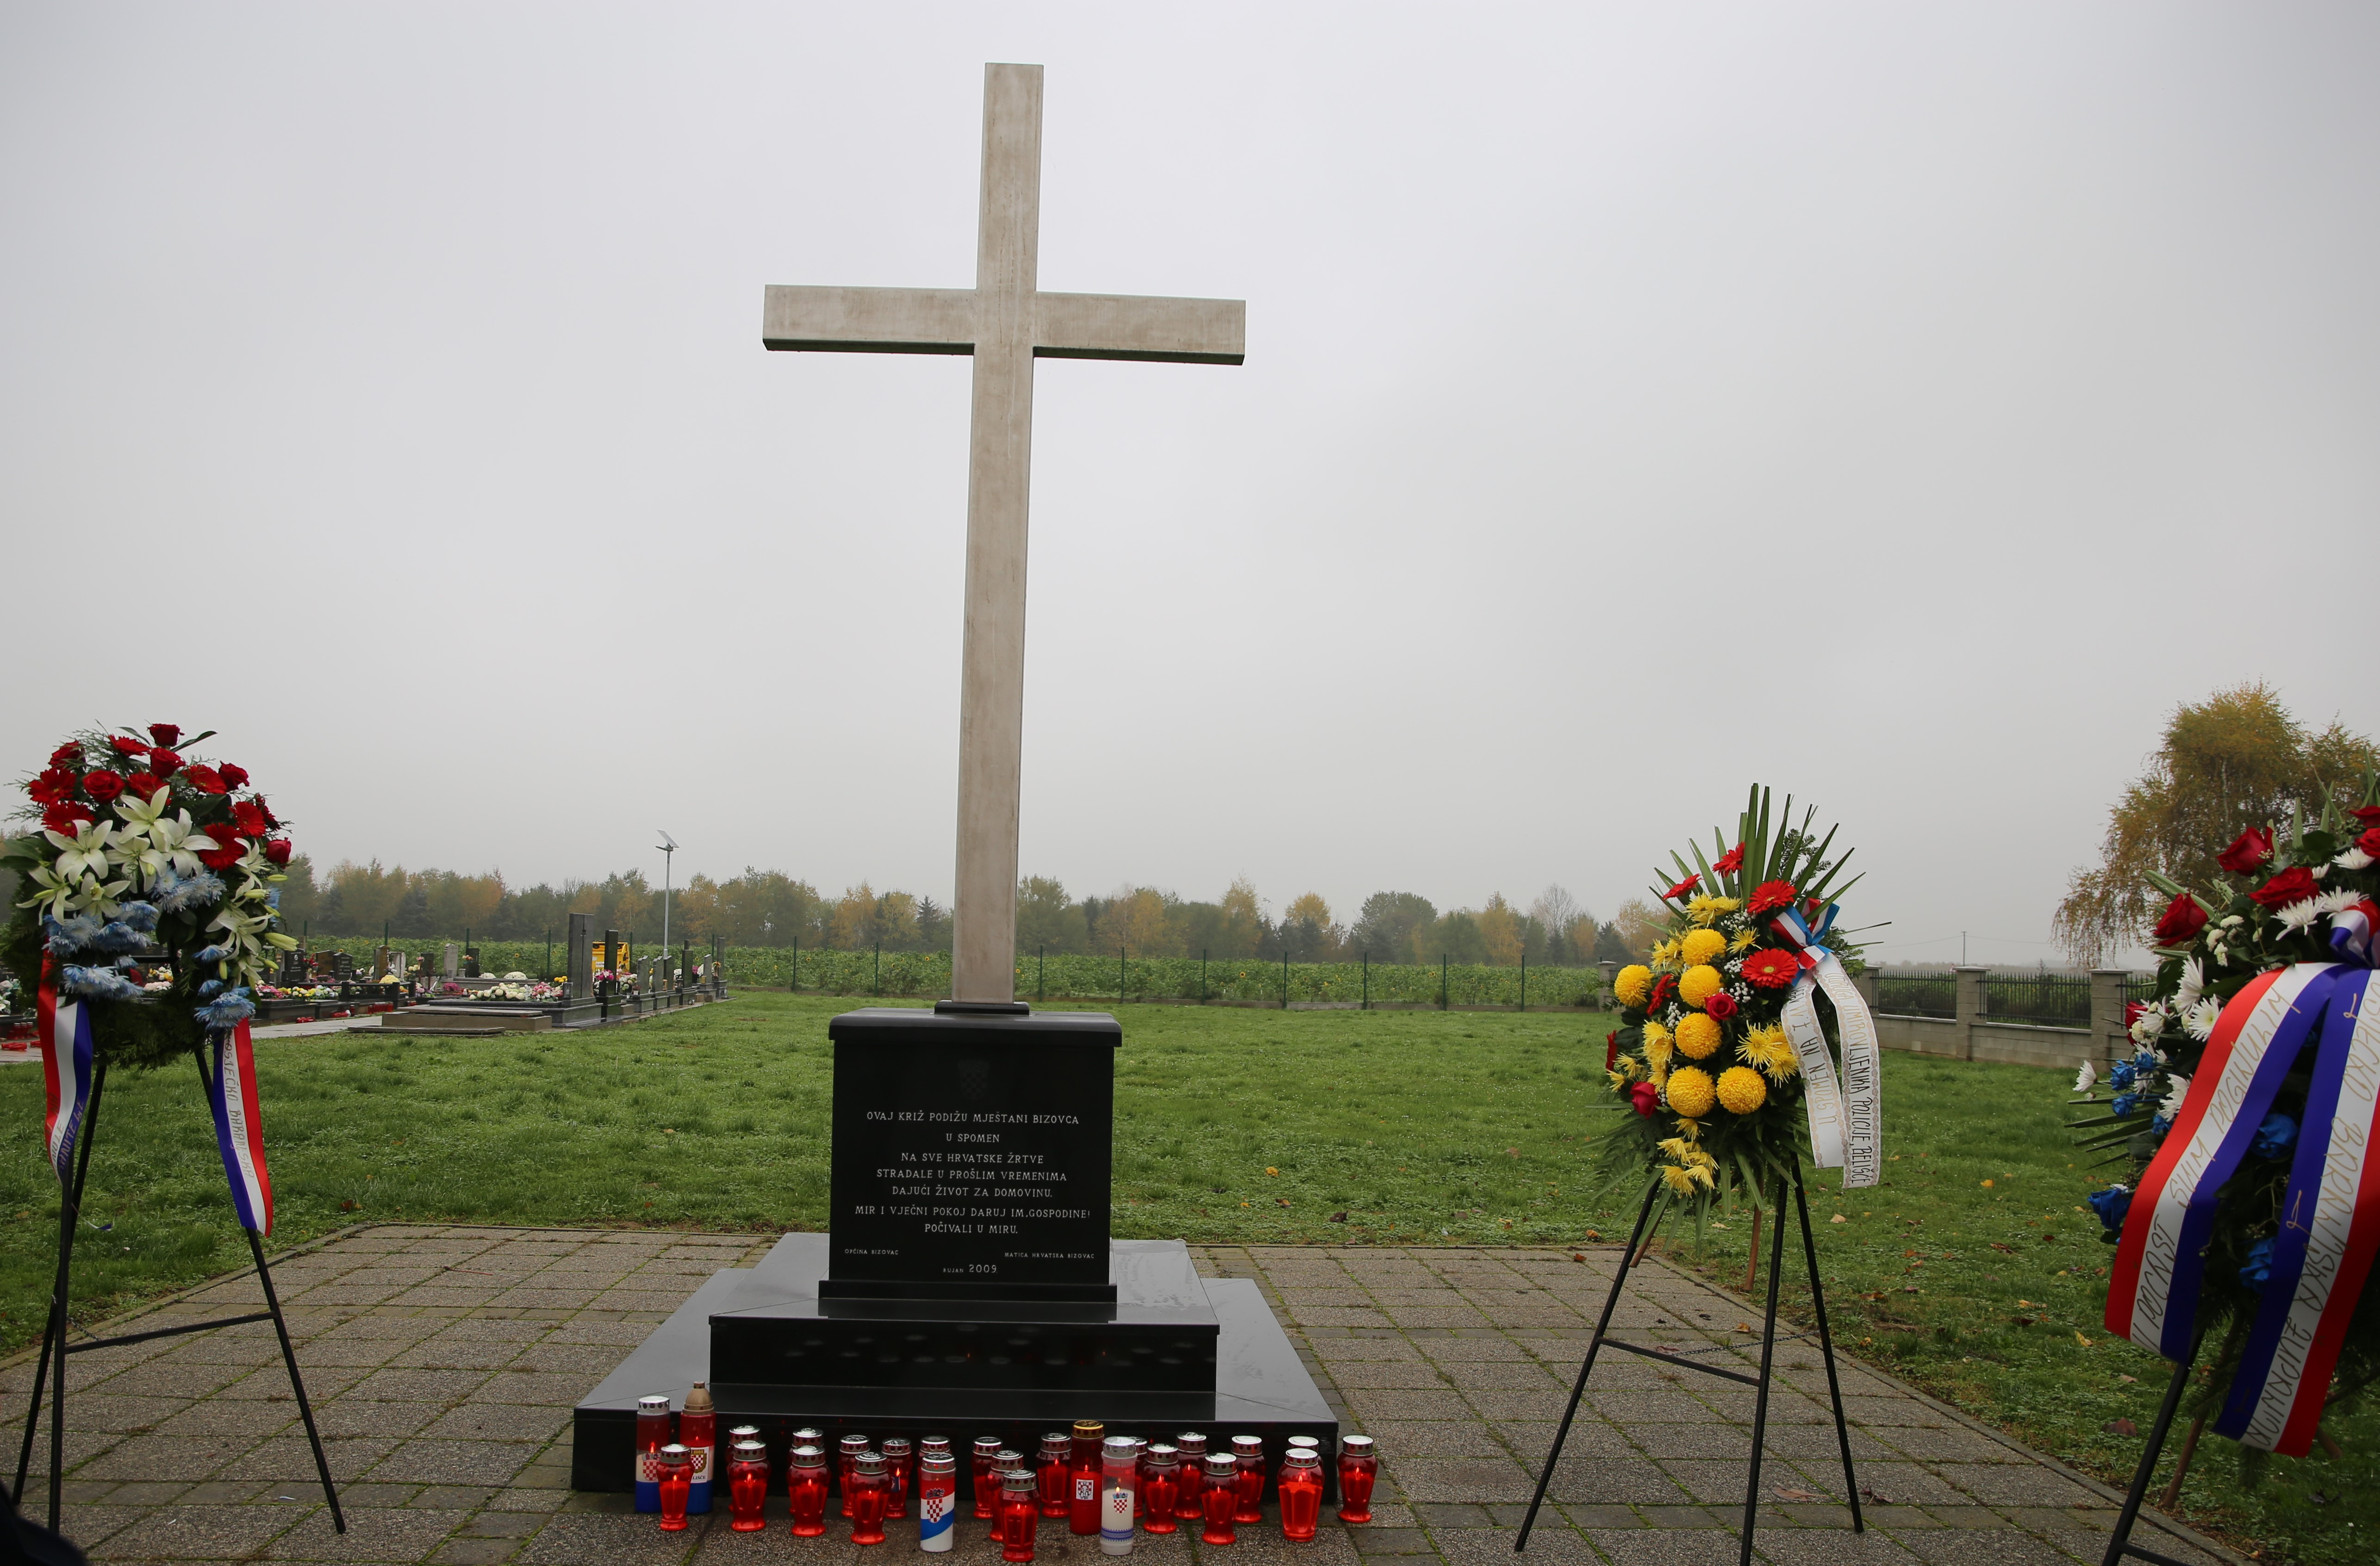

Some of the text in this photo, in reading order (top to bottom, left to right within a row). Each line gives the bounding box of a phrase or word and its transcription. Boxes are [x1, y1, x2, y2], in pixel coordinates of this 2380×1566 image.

[1800, 1037, 1820, 1056] NA
[1807, 1063, 1834, 1110] SPOMEN
[867, 1110, 1079, 1124] OVAJ KRIŽ PODIŽU MJEŠTANI BIZOVCA
[1818, 1115, 1837, 1125] U
[946, 1133, 1000, 1143] U SPOMEN
[901, 1152, 1044, 1164] NA SVE HRVATSKE ŽRTVE
[877, 1168, 1067, 1181] STRADALE U PROŠLIM VREMENIMA
[892, 1184, 1052, 1197] DAJUĆI ŽIVOT ZA DOMOVINU.
[855, 1206, 875, 1214] MIR
[881, 1206, 884, 1215] I
[890, 1204, 927, 1215] VJEČNI
[933, 1207, 966, 1216] POKOJ
[971, 1208, 1006, 1217] DARUJ
[925, 1221, 1018, 1234] POČIVALI U MIRU.
